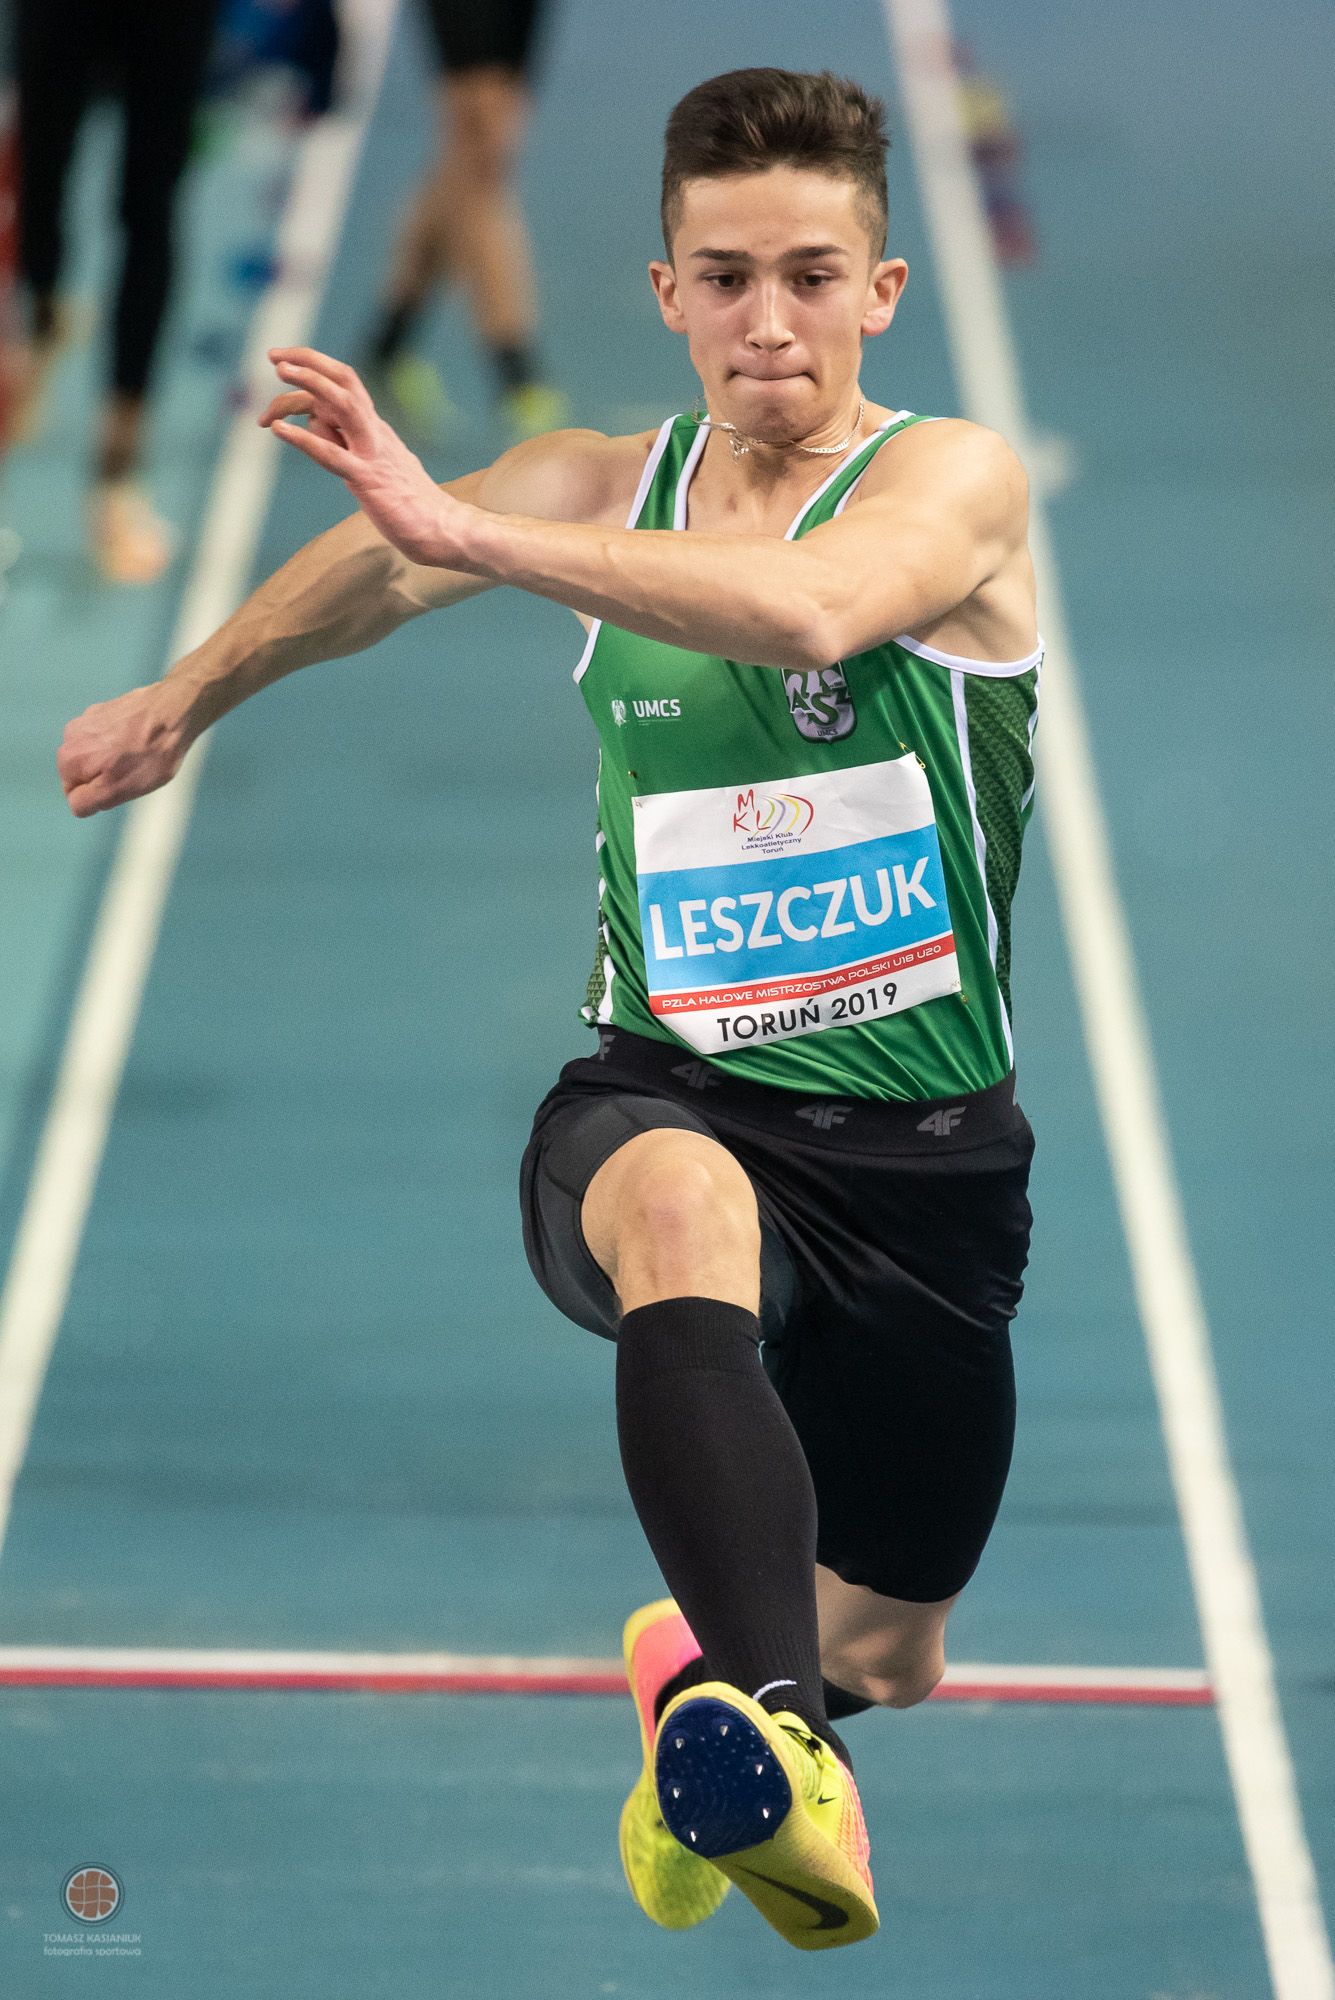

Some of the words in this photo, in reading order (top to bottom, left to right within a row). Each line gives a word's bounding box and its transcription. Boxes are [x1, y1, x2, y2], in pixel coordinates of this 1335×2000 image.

[632, 699, 681, 718] UMCS
[817, 728, 838, 737] UMCS
[741, 837, 802, 851] Lekkoatletyczny
[747, 834, 774, 843] Miejski
[775, 832, 794, 840] Klub
[761, 847, 784, 855] Toruń
[649, 856, 938, 960] LESZCZUK
[662, 998, 697, 1009] PZLA
[699, 990, 753, 1005] HALOWE
[756, 975, 847, 999] MISTRZOSTWA
[848, 961, 891, 981] POLSKI
[893, 953, 915, 967] U18
[917, 944, 942, 959] U20
[717, 998, 821, 1042] TORUŃ
[830, 982, 898, 1020] 2019
[795, 1102, 853, 1130] 4F
[916, 1106, 967, 1136] 4F
